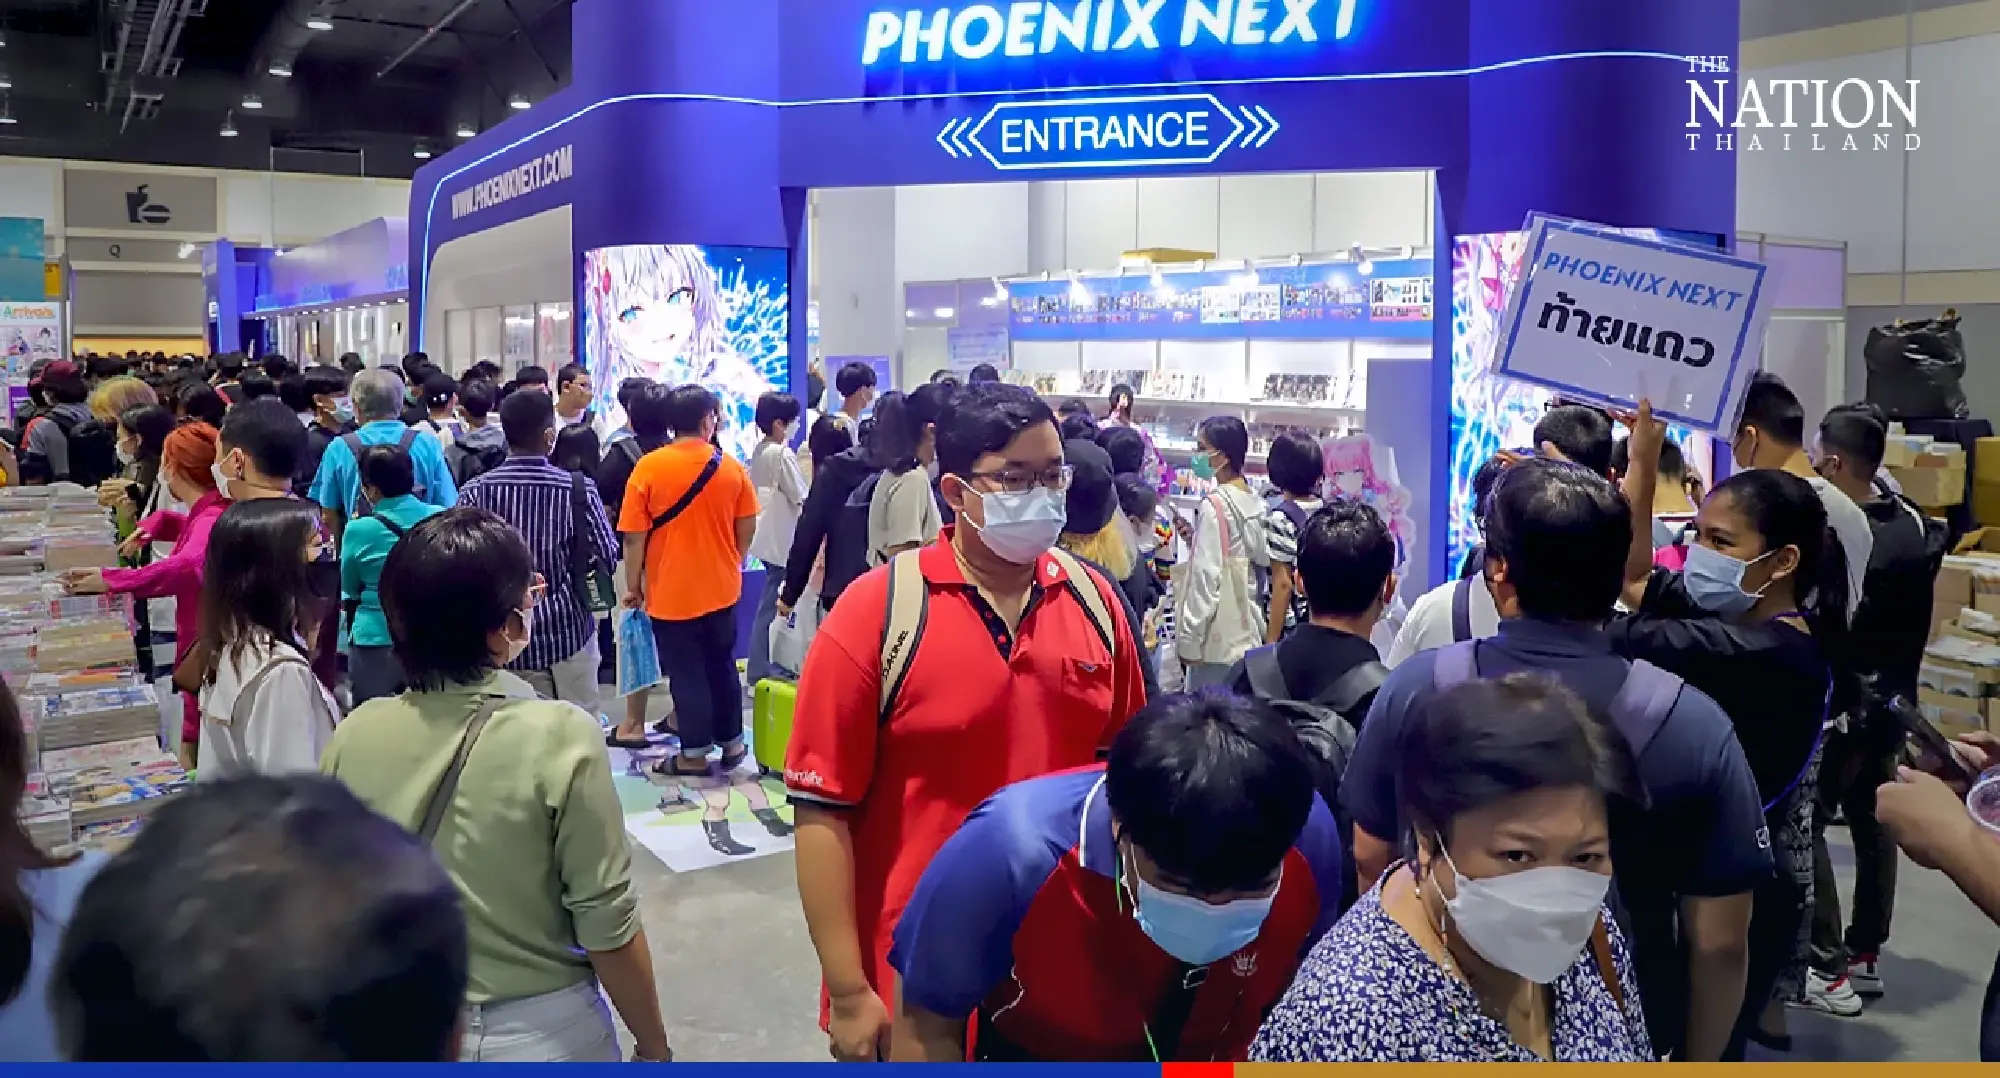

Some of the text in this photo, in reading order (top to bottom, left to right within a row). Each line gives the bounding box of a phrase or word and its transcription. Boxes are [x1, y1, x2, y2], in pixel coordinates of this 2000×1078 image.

[862, 0, 1163, 64] PHOENIX
[1002, 111, 1209, 153] ENTRANCE
[452, 144, 572, 219] WWW.PHOENIXNEXT.COM
[108, 244, 121, 258] Q
[1543, 252, 1743, 312] PHOENIX NEXT
[1537, 291, 1715, 367] ท้ายแถว
